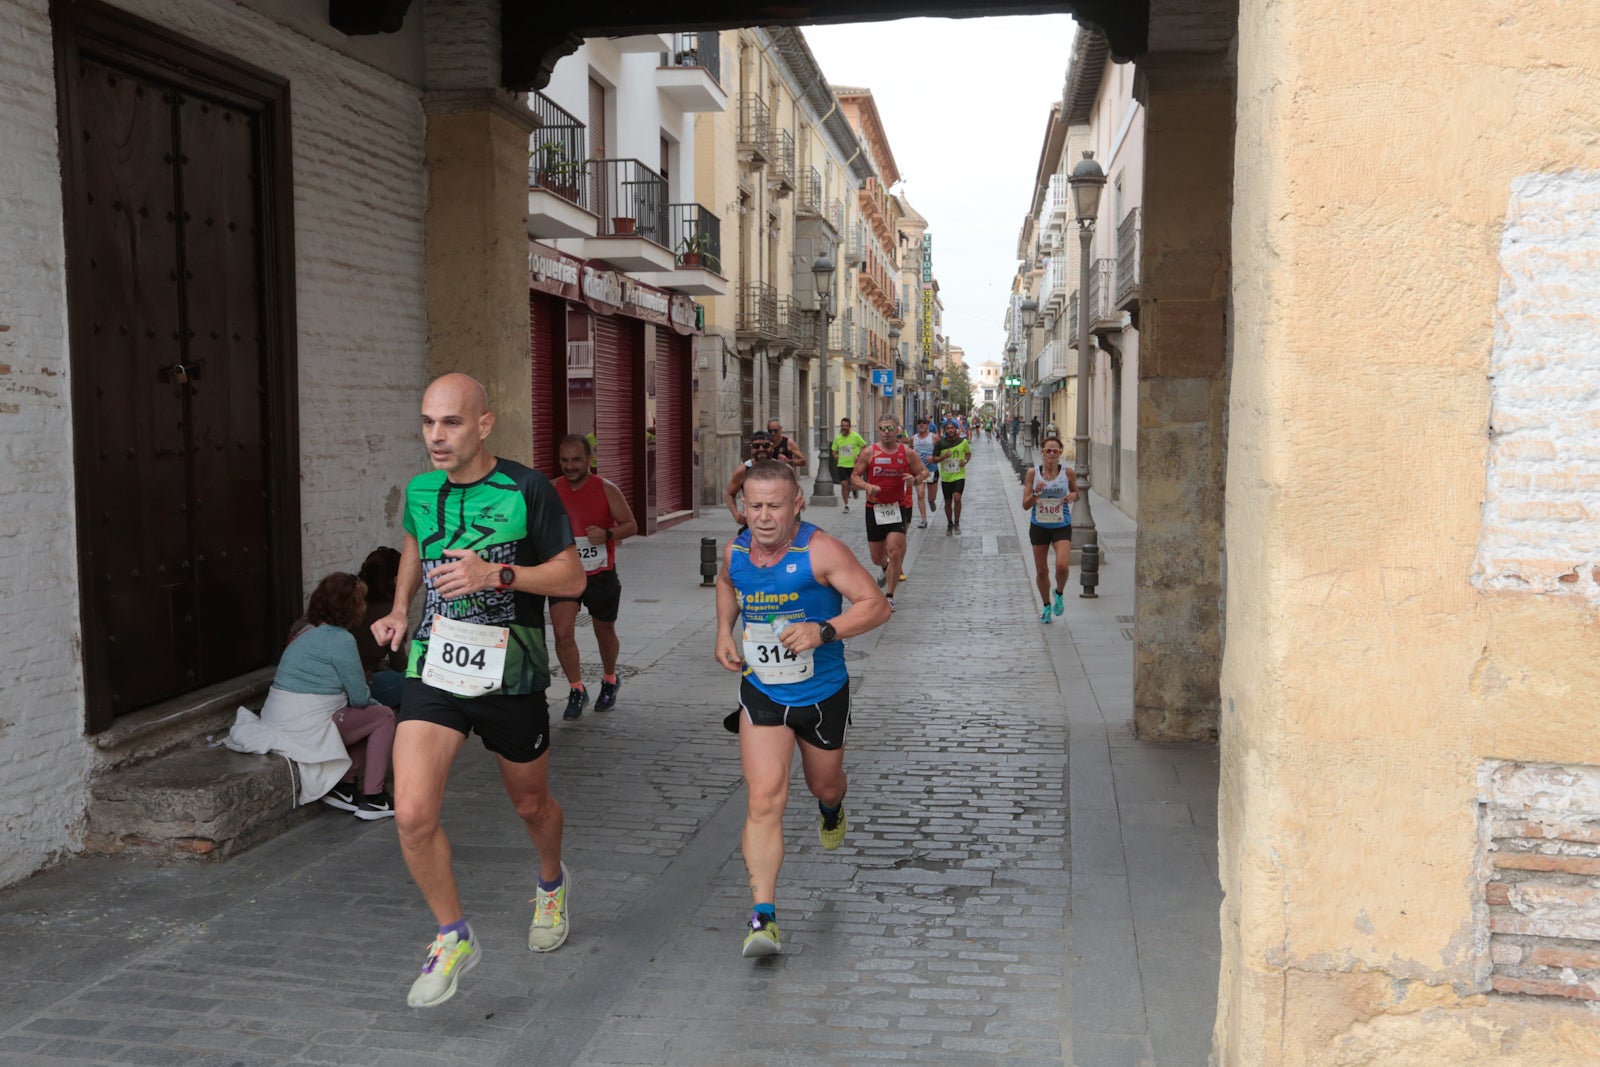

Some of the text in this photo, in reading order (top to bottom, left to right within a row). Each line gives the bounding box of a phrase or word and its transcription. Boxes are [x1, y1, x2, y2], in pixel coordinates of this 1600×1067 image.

[923, 235, 931, 282] TEJIDOS
[923, 290, 931, 364] CONFECCION
[746, 592, 799, 606] olimpo
[746, 604, 779, 612] deportes
[442, 642, 486, 670] 804
[757, 645, 797, 664] 314
